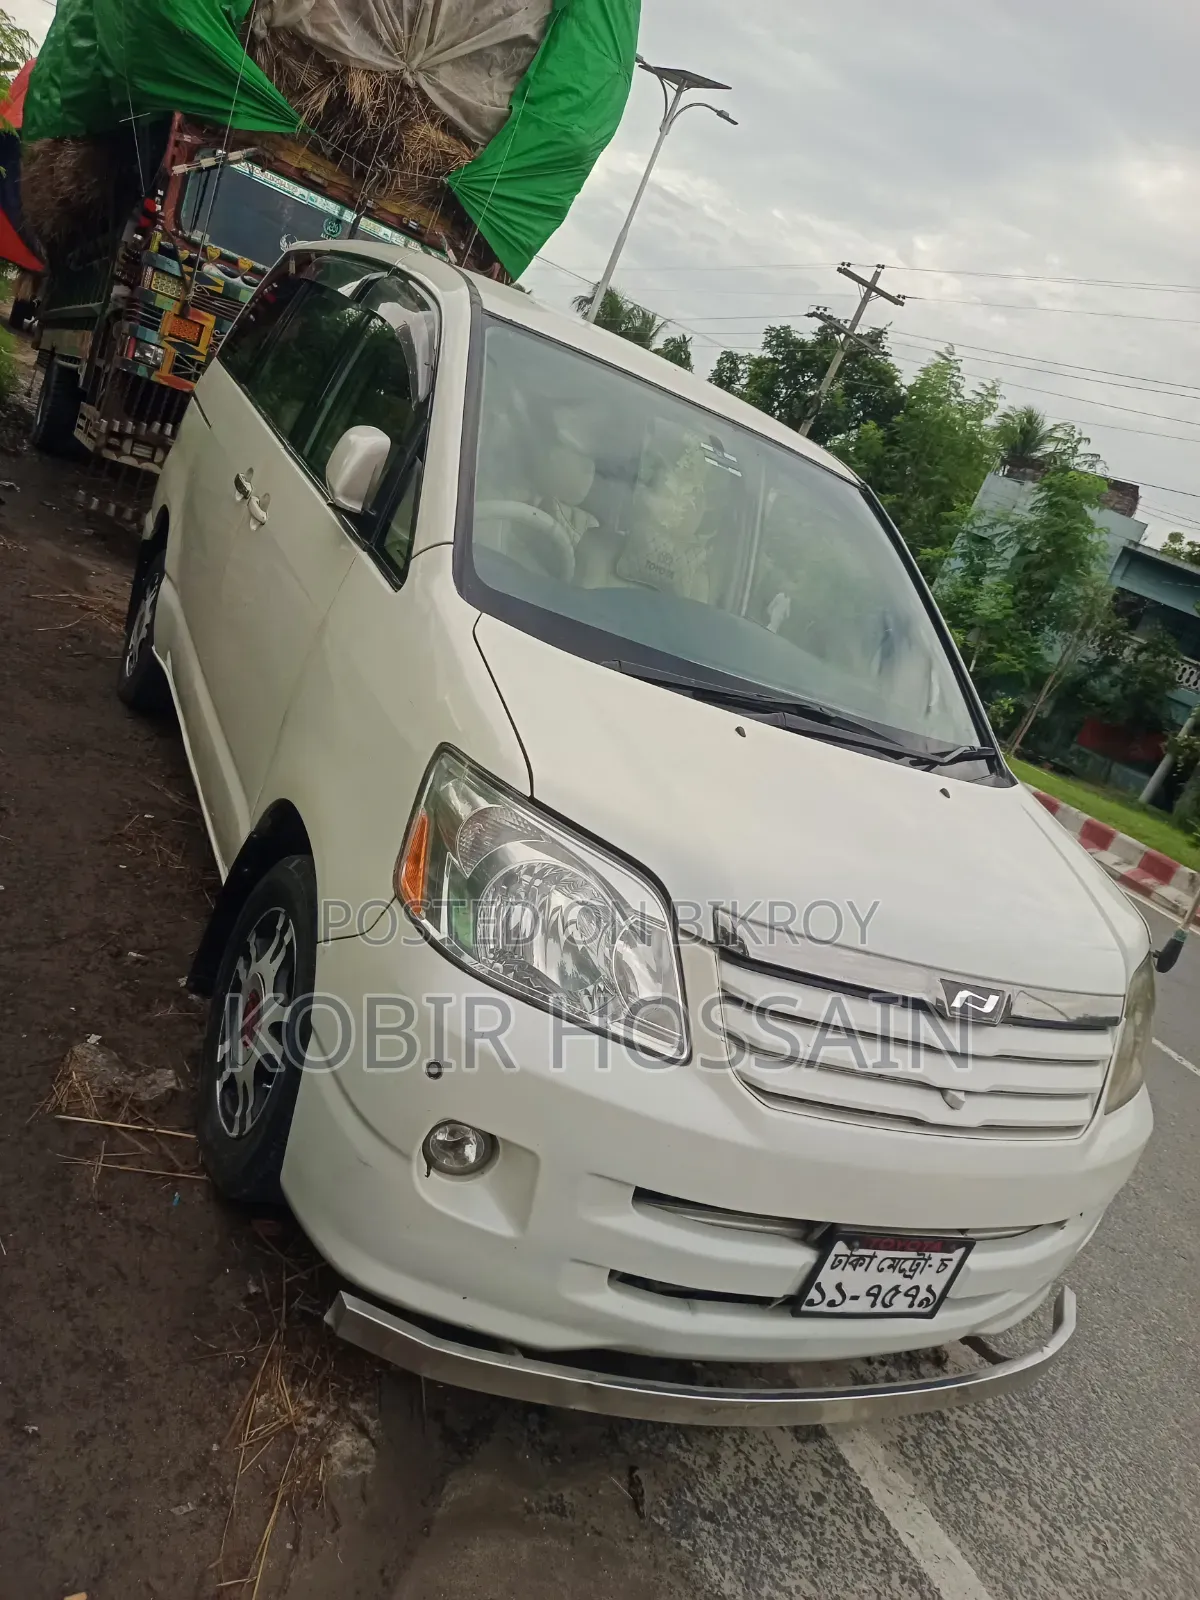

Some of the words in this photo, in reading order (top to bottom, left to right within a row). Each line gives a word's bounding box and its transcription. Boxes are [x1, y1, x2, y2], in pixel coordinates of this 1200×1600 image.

[646, 559, 675, 580] TOYOTA
[869, 1238, 943, 1252] TOYOTA
[830, 1251, 877, 1273] ঢাকা
[804, 1281, 937, 1309] ১১-৭৫৭৯
